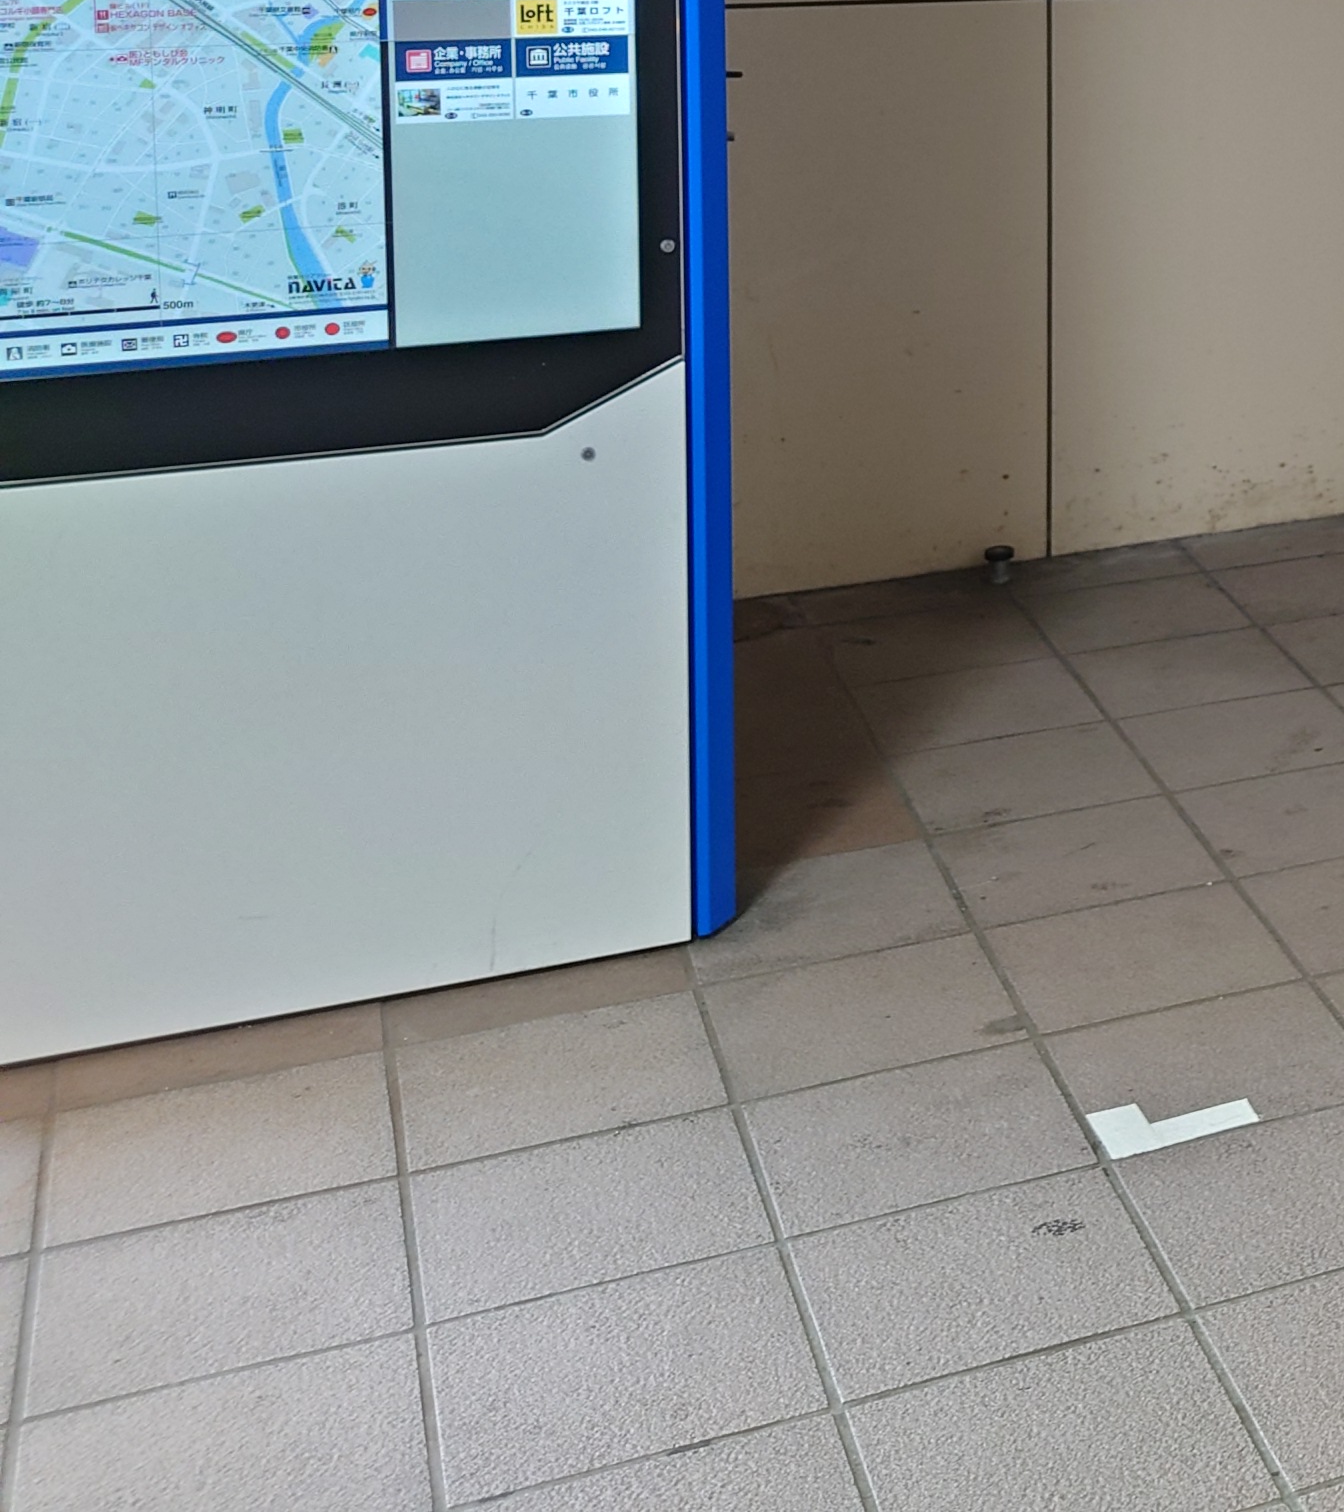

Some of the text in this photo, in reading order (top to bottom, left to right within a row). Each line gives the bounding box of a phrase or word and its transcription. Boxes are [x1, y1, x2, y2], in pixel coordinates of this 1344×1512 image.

[110, 10, 164, 18] HEXAGON
[564, 7, 624, 15] 千葉ロフト
[434, 45, 502, 60] 企業・事務所
[553, 42, 610, 56] 公共施設
[527, 87, 619, 98] 千葉市役所
[163, 301, 194, 309] 500m
